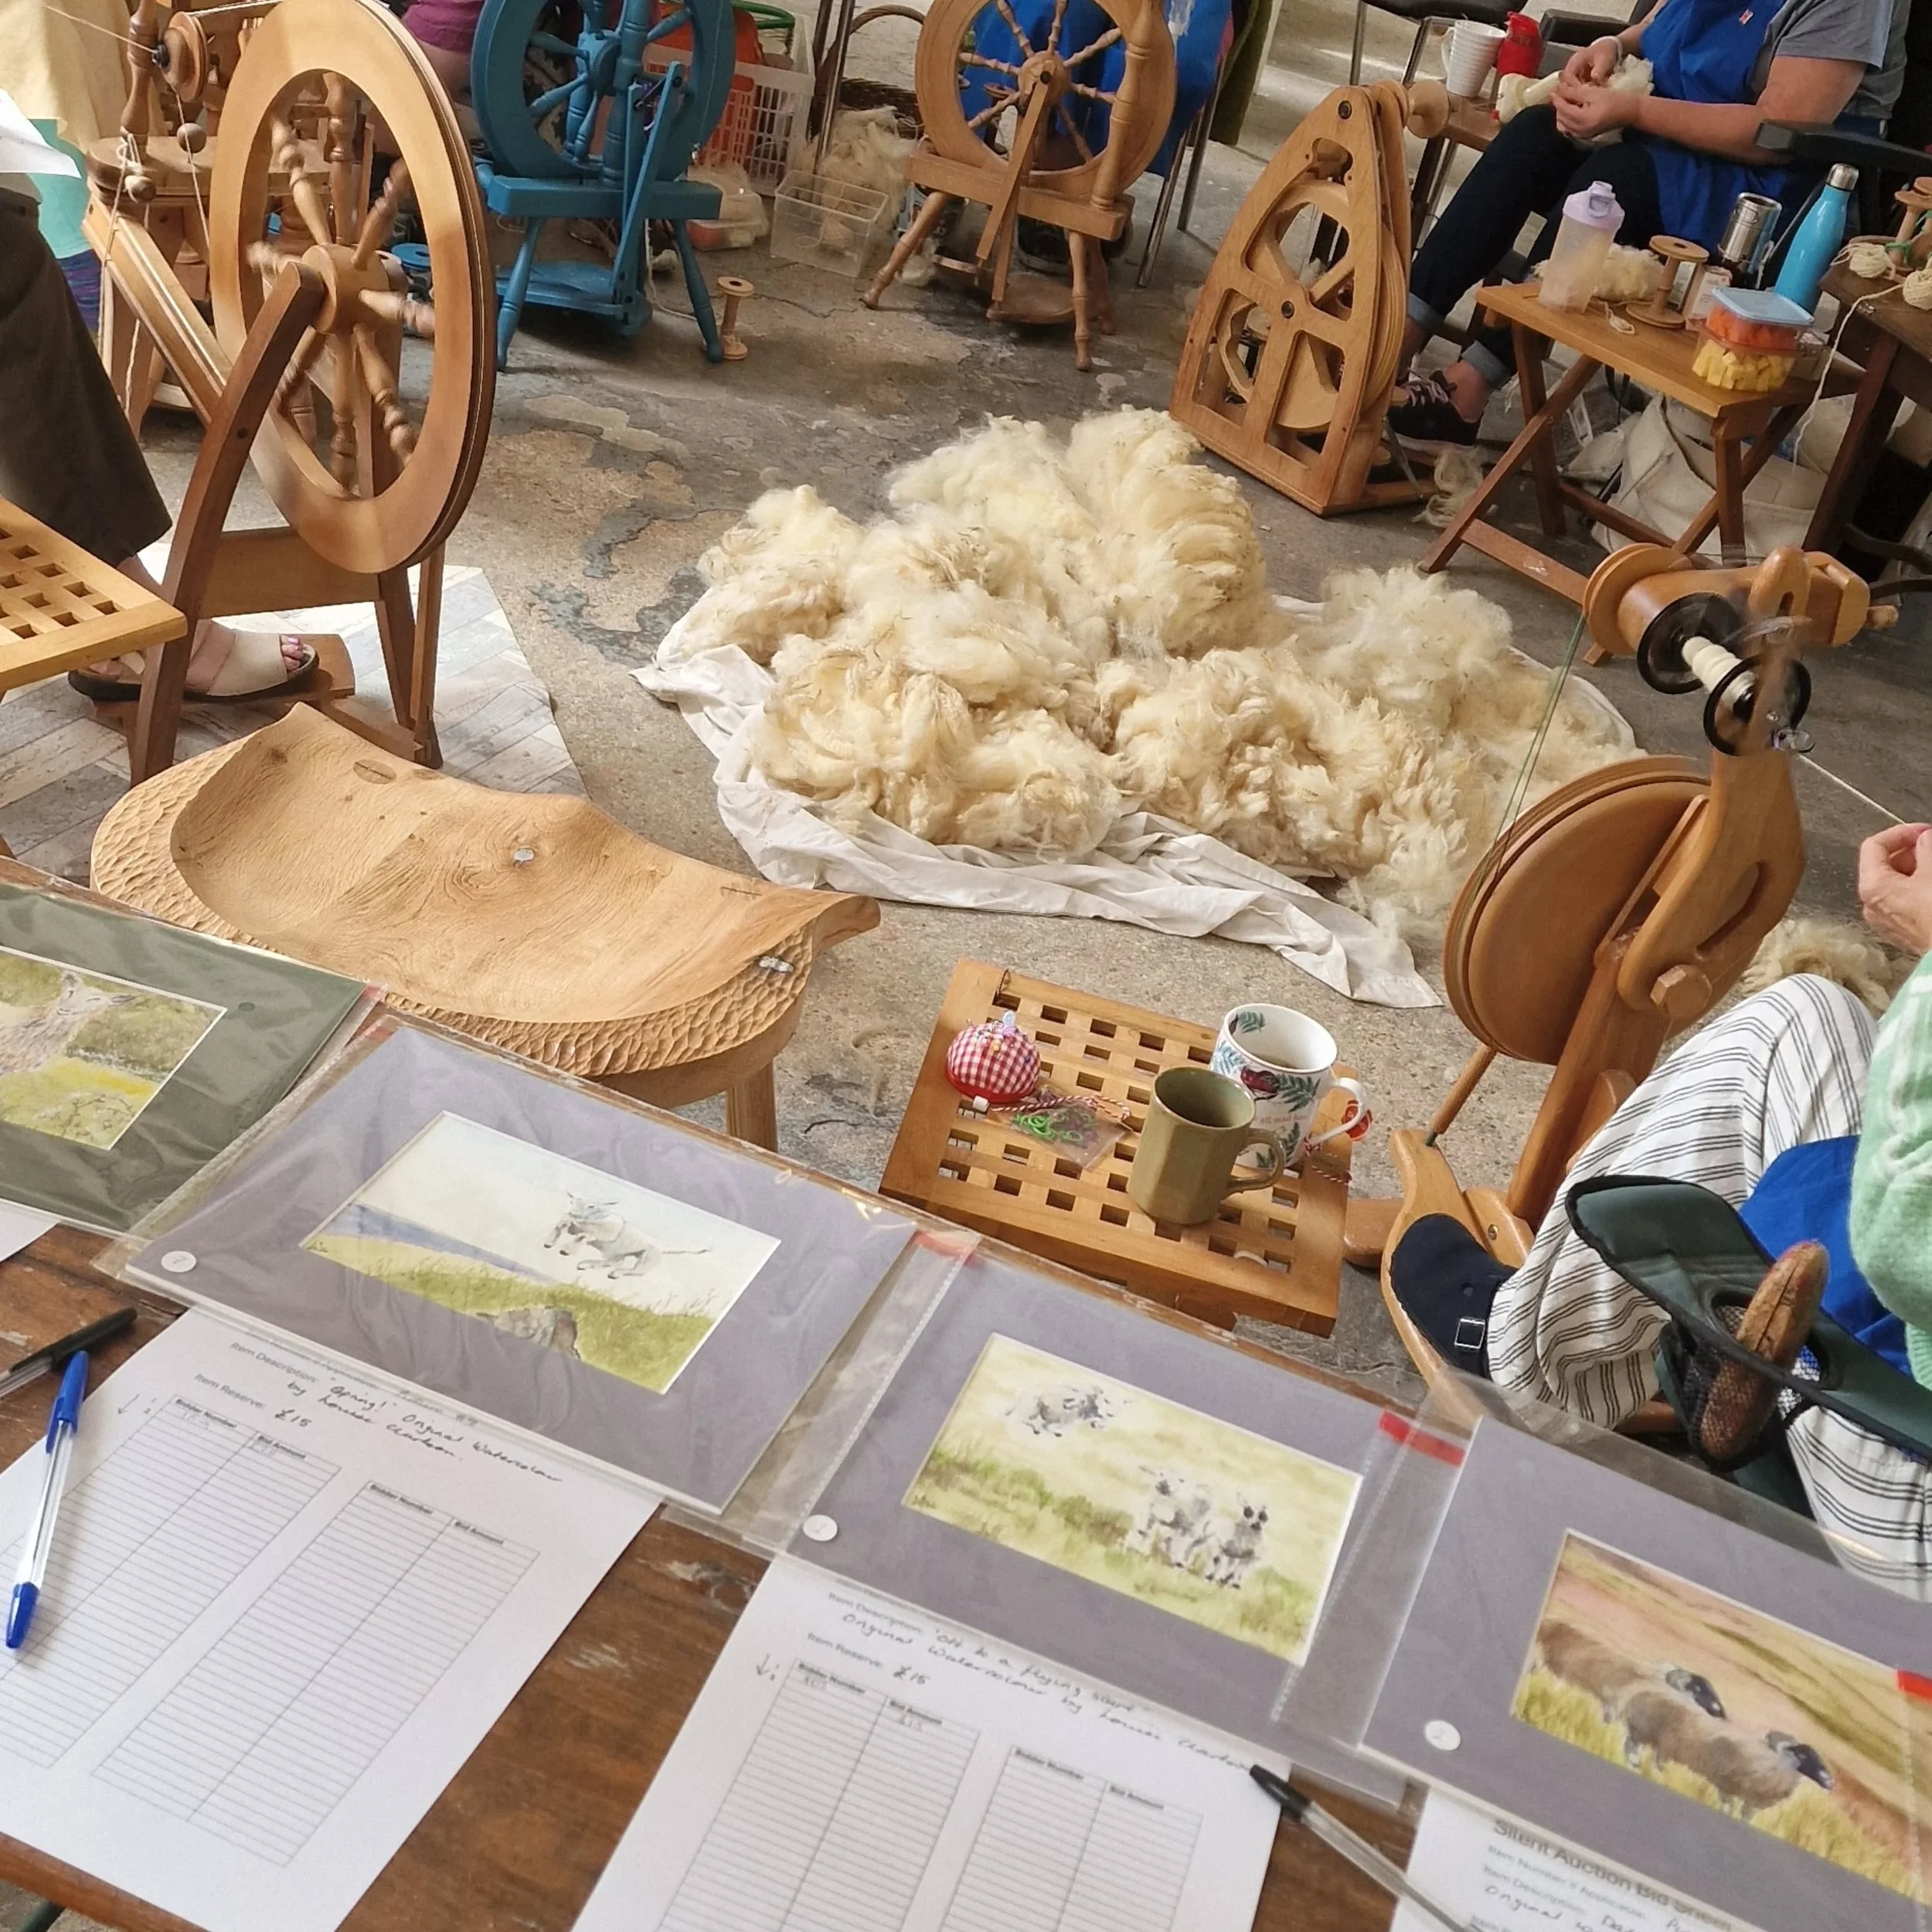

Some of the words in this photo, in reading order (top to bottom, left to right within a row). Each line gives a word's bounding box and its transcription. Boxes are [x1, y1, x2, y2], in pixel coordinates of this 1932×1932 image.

[231, 1342, 255, 1356] Item
[194, 1373, 219, 1390] Item
[287, 1381, 307, 1397] by
[203, 1411, 238, 1429] Number
[274, 1407, 313, 1428] £15
[828, 1592, 854, 1610] Item
[806, 1631, 833, 1650] Item
[892, 1664, 932, 1686] £15
[1061, 1696, 1083, 1715] by
[1493, 1818, 1553, 1855] Silent
[1553, 1847, 1631, 1892] Auction
[1635, 1881, 1670, 1907] Bid
